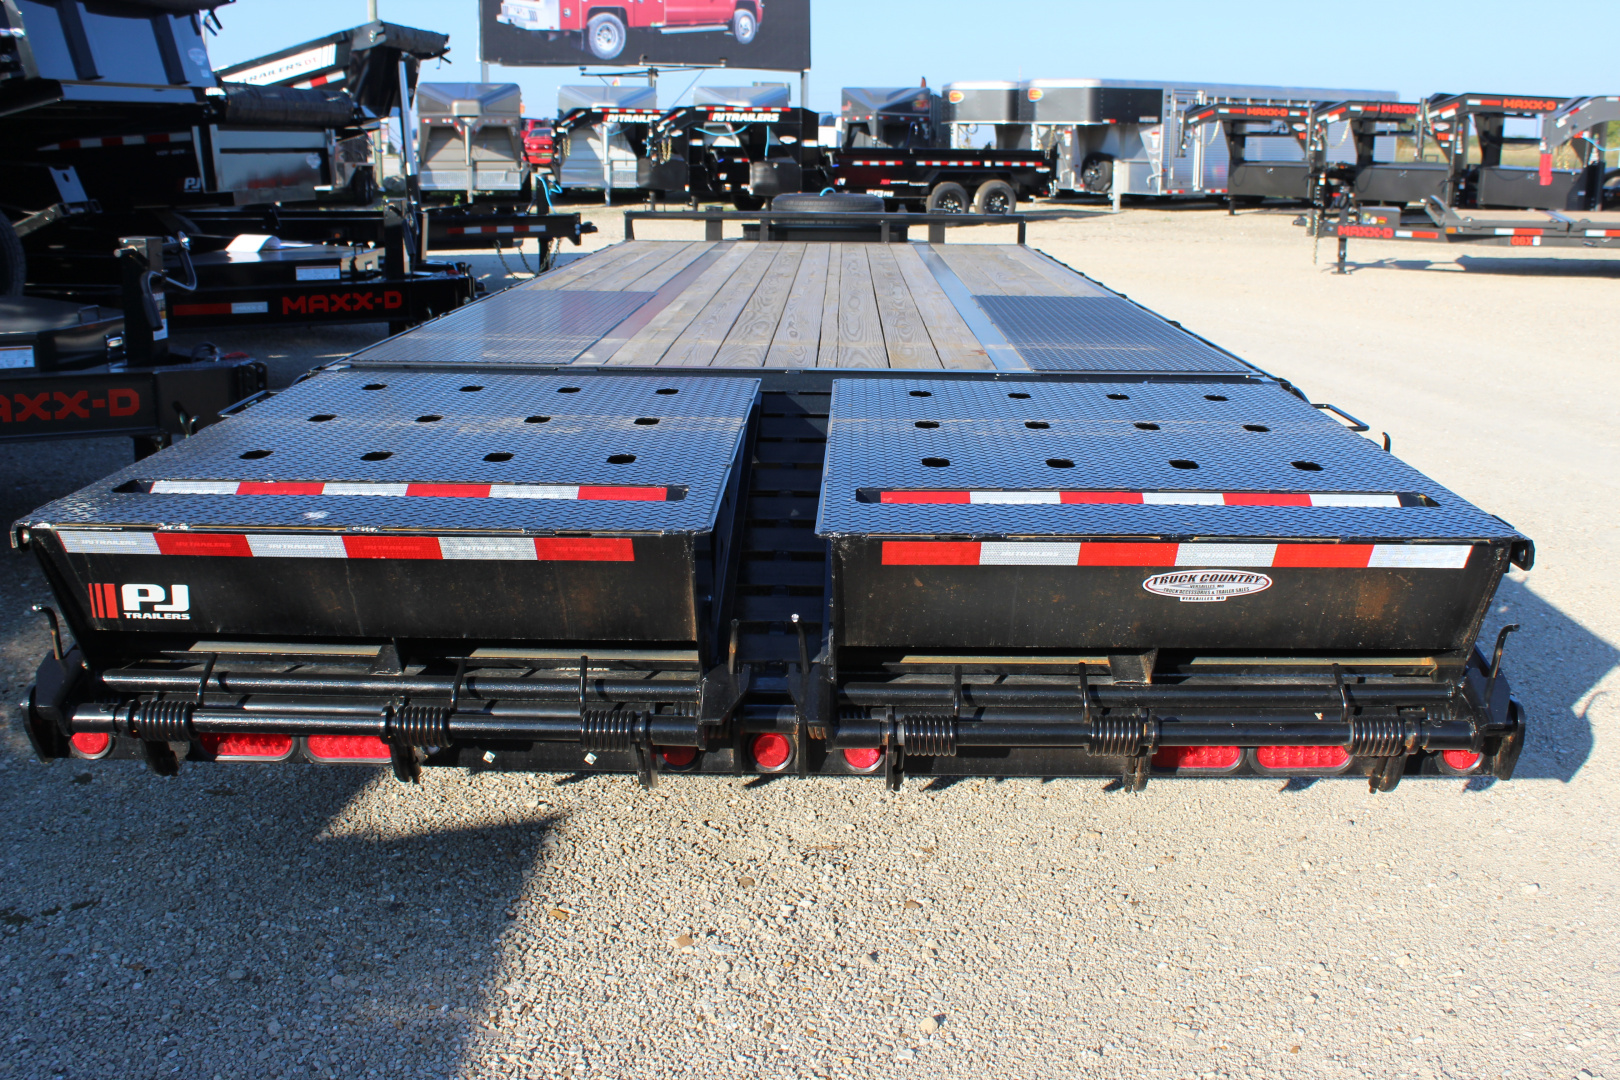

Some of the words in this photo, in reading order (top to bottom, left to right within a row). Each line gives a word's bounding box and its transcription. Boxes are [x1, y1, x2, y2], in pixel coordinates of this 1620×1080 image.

[1381, 104, 1420, 114] MAXX-
[1503, 98, 1557, 111] MAXX-D
[723, 112, 780, 122] TRAILERS
[1246, 107, 1289, 117] MAXX-D
[618, 114, 661, 123] TRAILER
[1337, 225, 1394, 239] MAXX-D
[282, 290, 402, 315] MAXX-D
[1152, 574, 1198, 585] TRUCK
[1199, 573, 1264, 584] COUNTRY
[121, 583, 190, 612] PJ
[124, 612, 190, 620] TRAILERS
